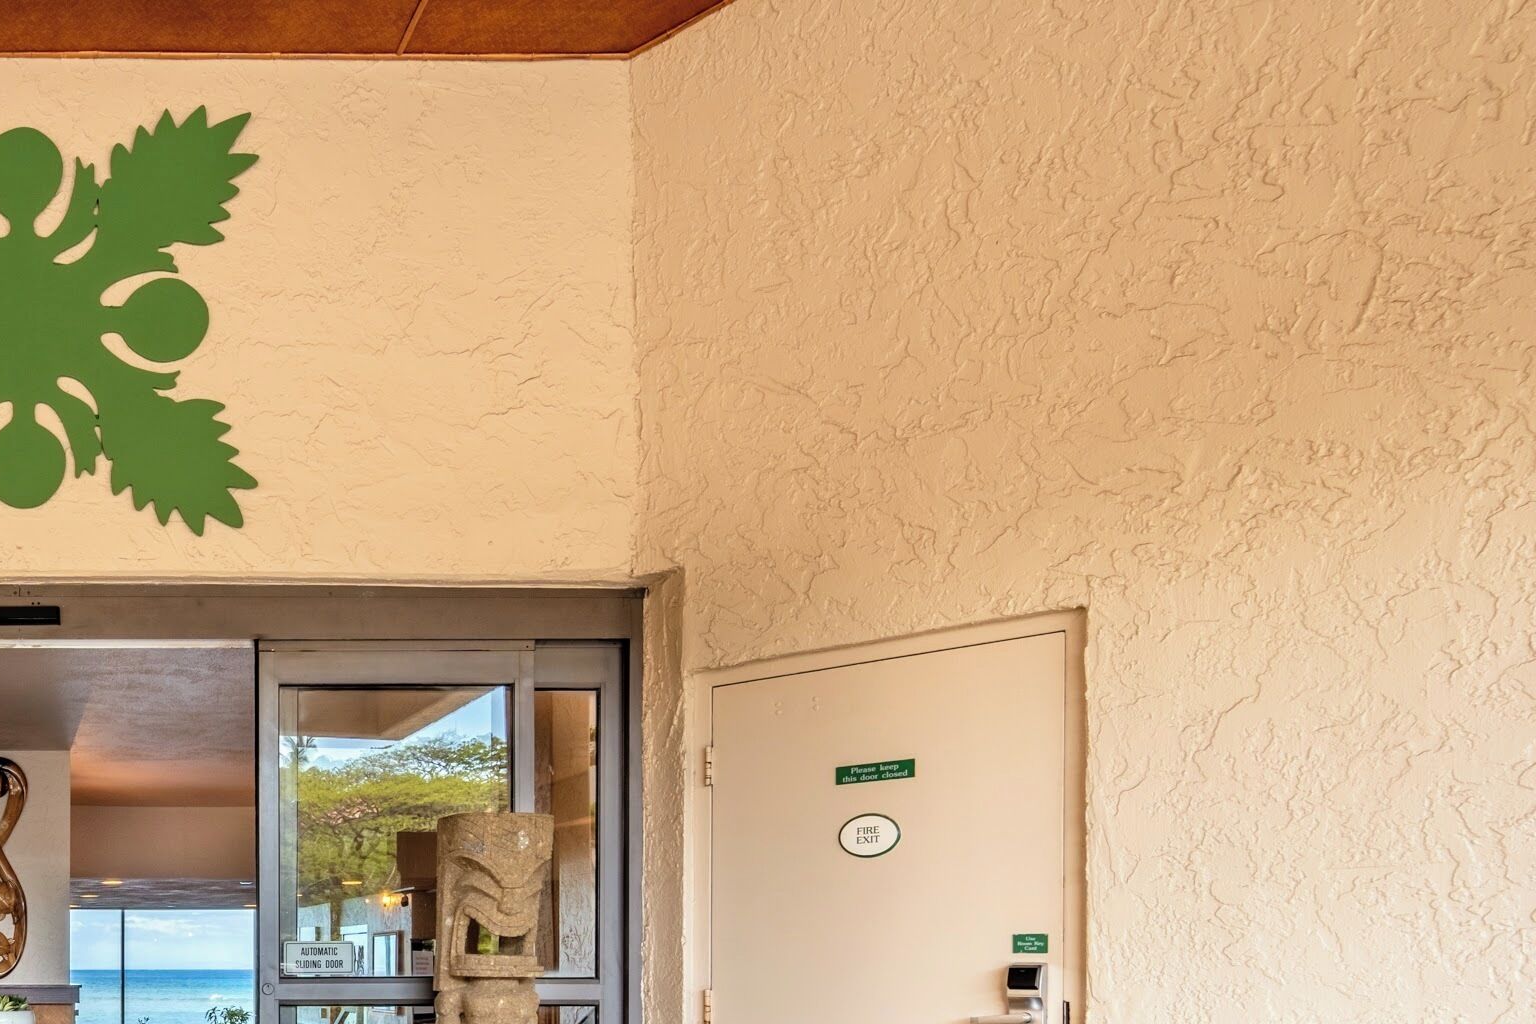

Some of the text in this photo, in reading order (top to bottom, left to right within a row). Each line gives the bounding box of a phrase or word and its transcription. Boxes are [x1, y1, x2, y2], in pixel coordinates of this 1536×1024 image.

[850, 766, 876, 774] Please
[842, 769, 908, 783] this door closed
[856, 826, 880, 844] FIRE EXIT
[300, 947, 338, 956] AUTOMATIC
[295, 960, 344, 968] SLIDING DOOR
